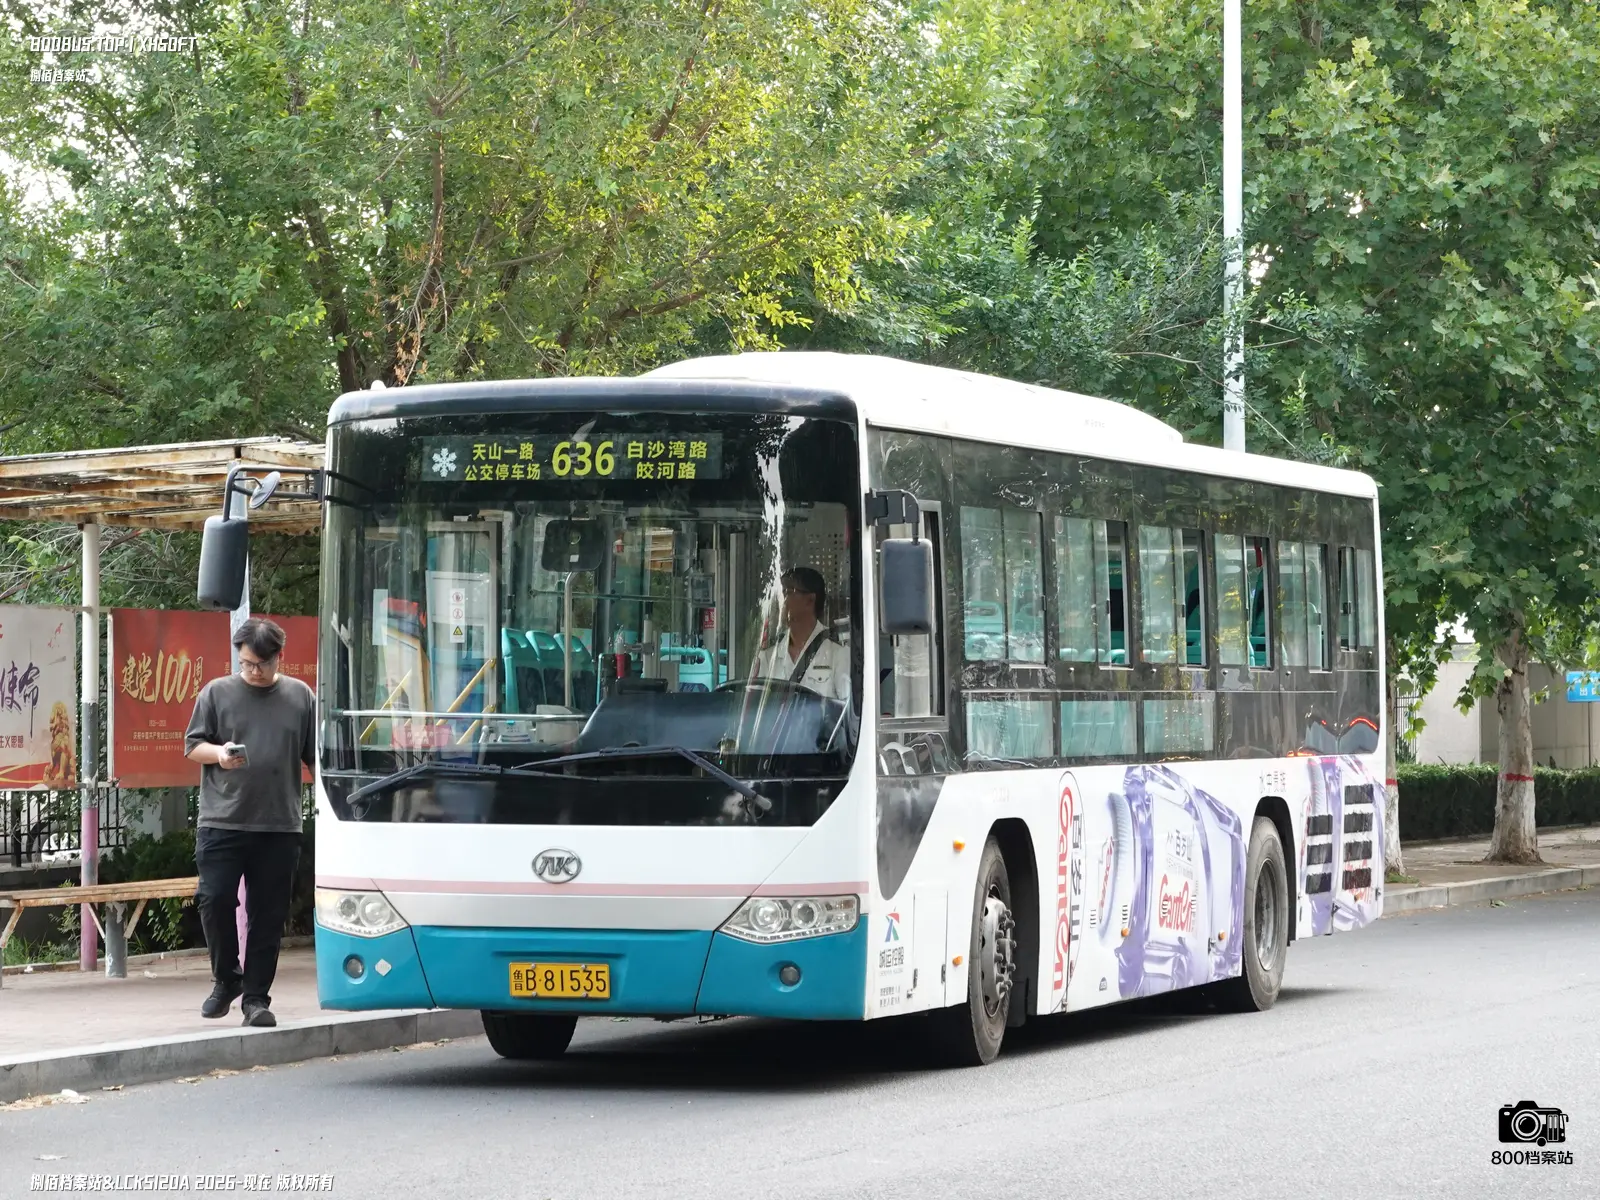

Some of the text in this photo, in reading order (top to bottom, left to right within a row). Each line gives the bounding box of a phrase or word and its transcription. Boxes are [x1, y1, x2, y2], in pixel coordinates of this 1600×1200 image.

[472, 442, 534, 461] 天山一路
[551, 441, 615, 477] 636
[627, 441, 708, 459] 白沙湾路
[464, 463, 541, 481] 公交停车场
